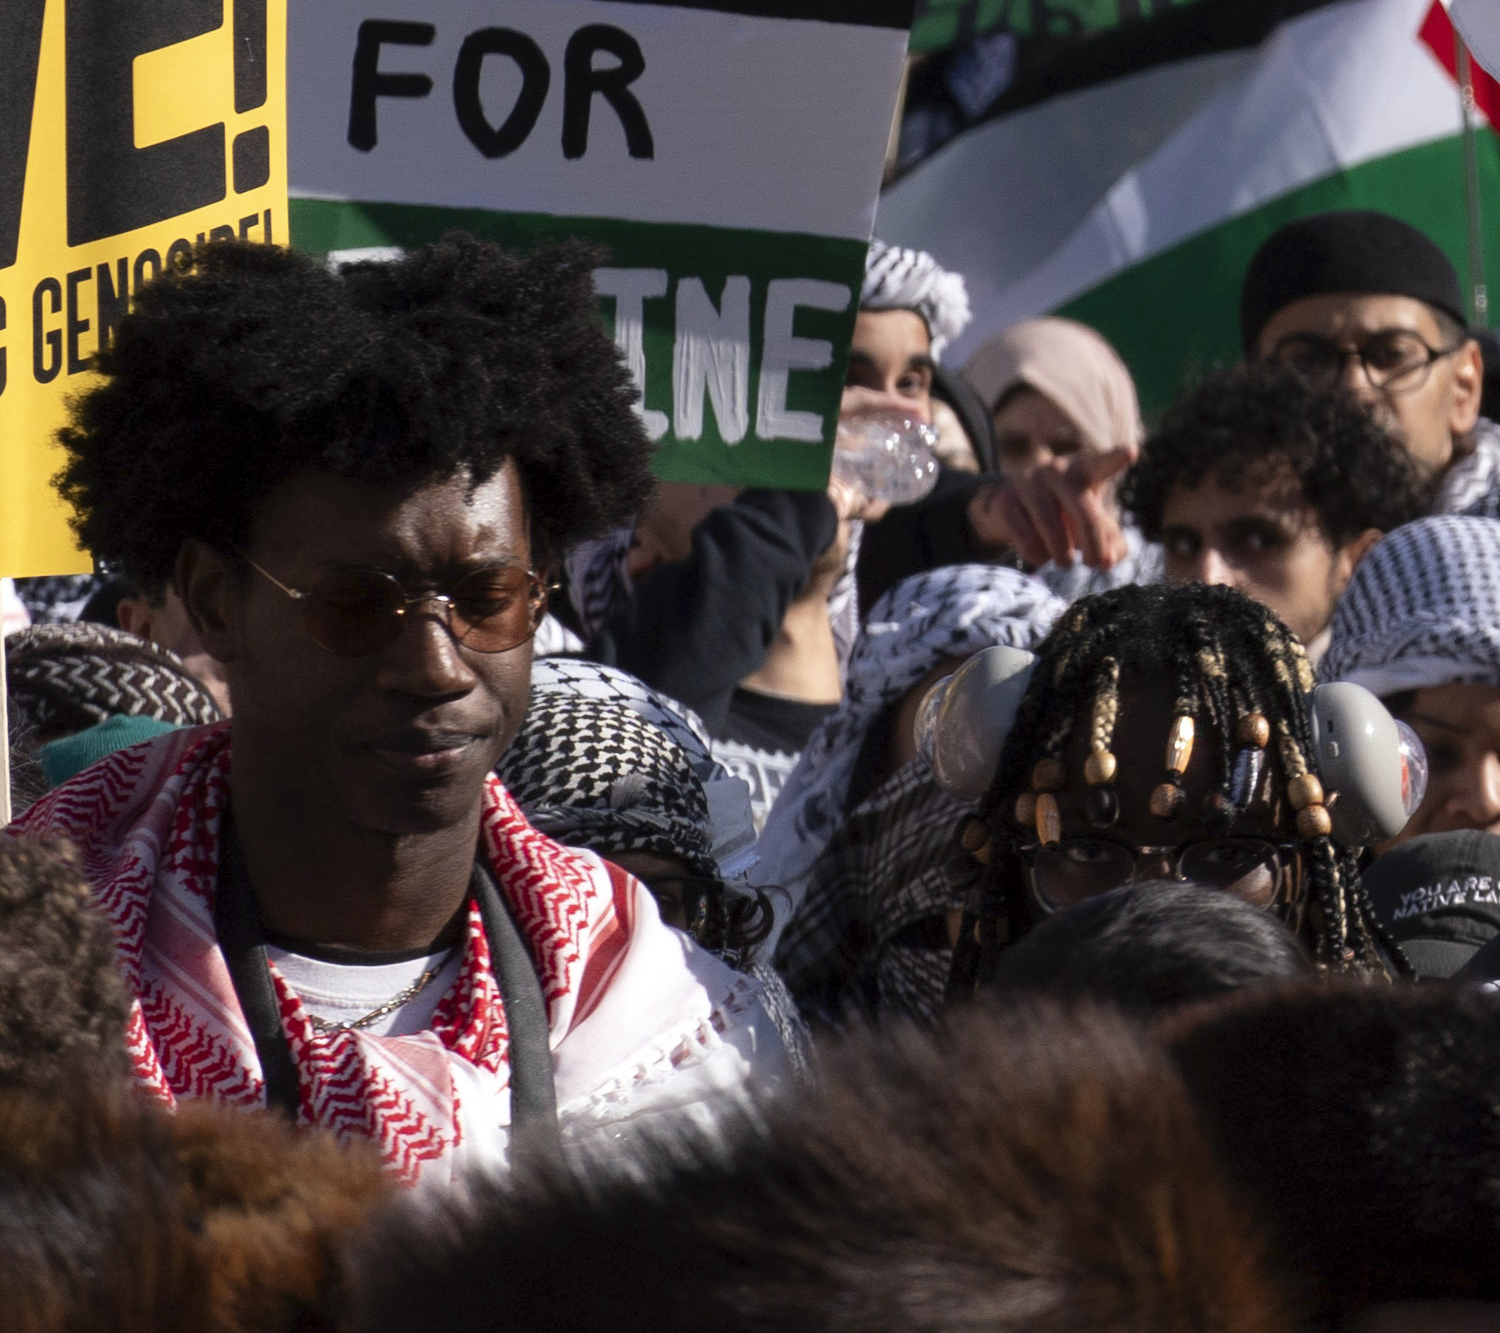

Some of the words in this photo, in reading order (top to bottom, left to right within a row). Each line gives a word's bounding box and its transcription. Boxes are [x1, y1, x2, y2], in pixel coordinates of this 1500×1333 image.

[347, 18, 654, 160] FOR
[1400, 883, 1442, 905] YOU
[1446, 876, 1492, 895] ARE
[1392, 891, 1467, 921] NATIVE
